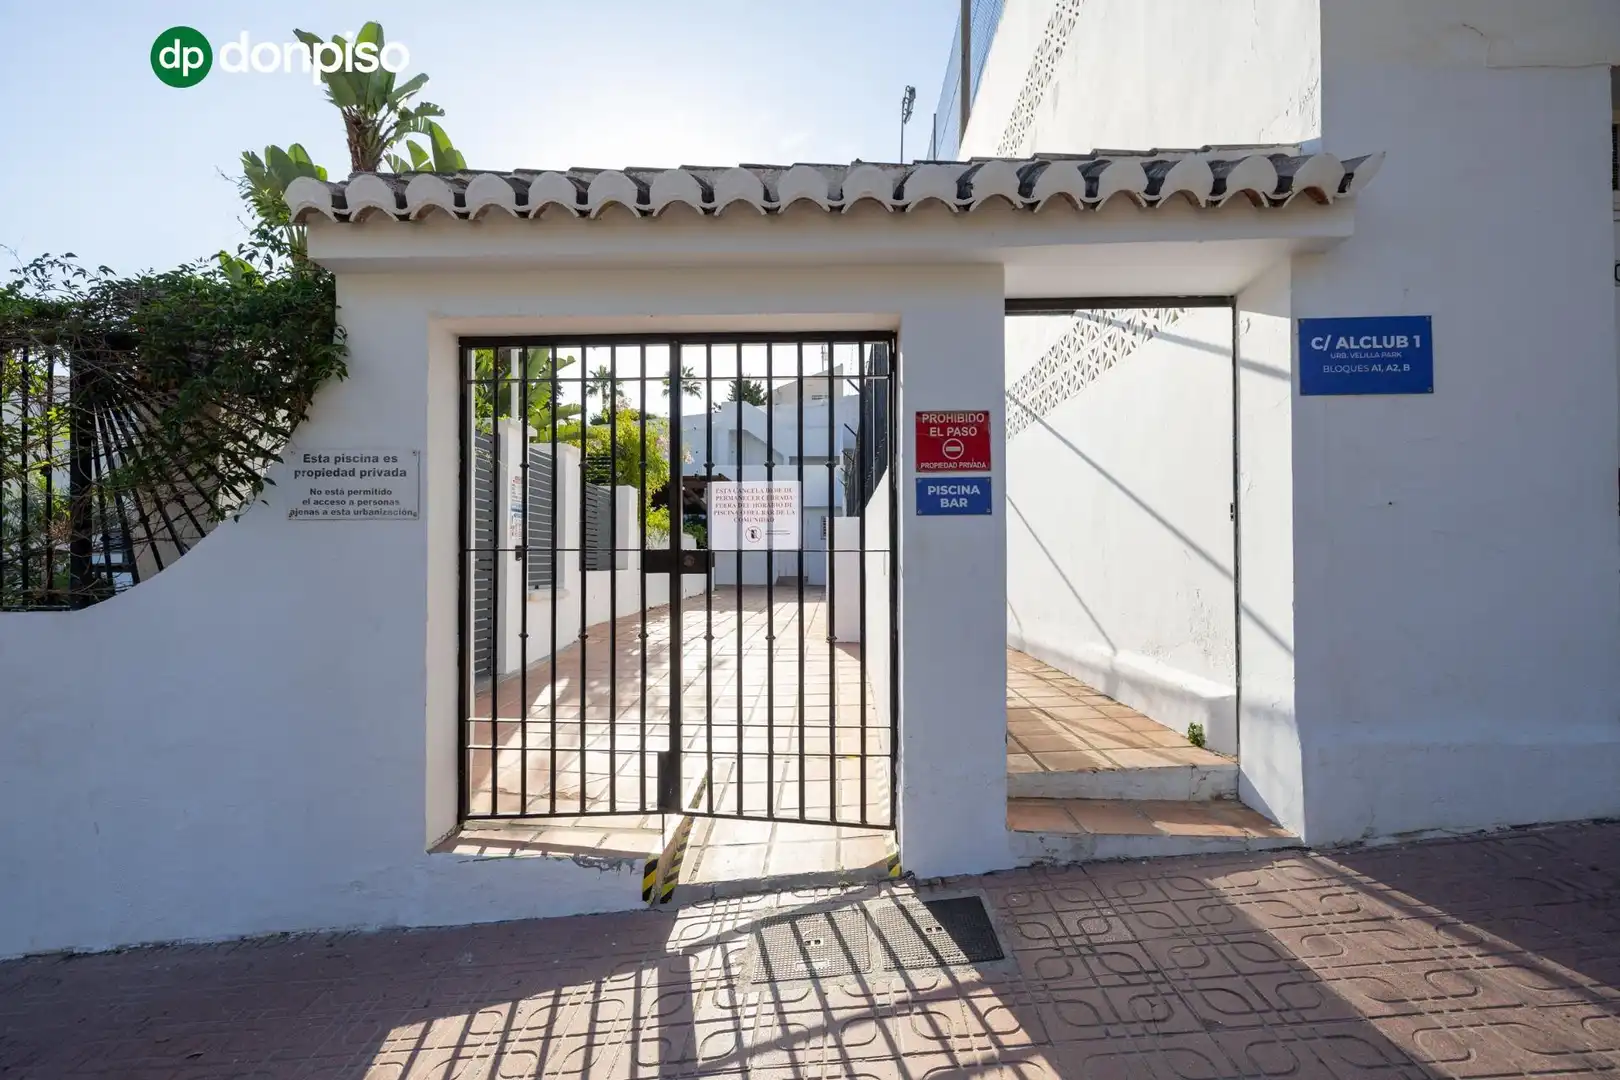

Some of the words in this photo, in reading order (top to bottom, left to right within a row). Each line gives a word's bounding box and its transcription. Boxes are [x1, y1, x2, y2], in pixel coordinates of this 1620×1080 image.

[1311, 334, 1332, 351] C/
[1336, 335, 1409, 350] ALCLUB
[1413, 335, 1421, 348] 1
[1323, 364, 1370, 373] BLOQUES
[1371, 364, 1384, 373] A1,
[1386, 364, 1401, 372] A2,
[1403, 363, 1411, 372] B
[922, 413, 985, 423] PROHIBIDO
[929, 427, 944, 437] EL
[947, 426, 978, 436] PASO
[303, 453, 330, 463] Esta
[334, 453, 379, 465] piscina
[383, 455, 398, 463] es
[294, 467, 356, 479] propiedad
[359, 467, 407, 479] privada
[309, 488, 322, 496] No
[325, 487, 345, 496] está
[347, 487, 393, 497] permitido
[927, 485, 980, 495] PISCINA
[302, 498, 311, 506] el
[357, 499, 400, 507] personas
[940, 498, 968, 508] BAR
